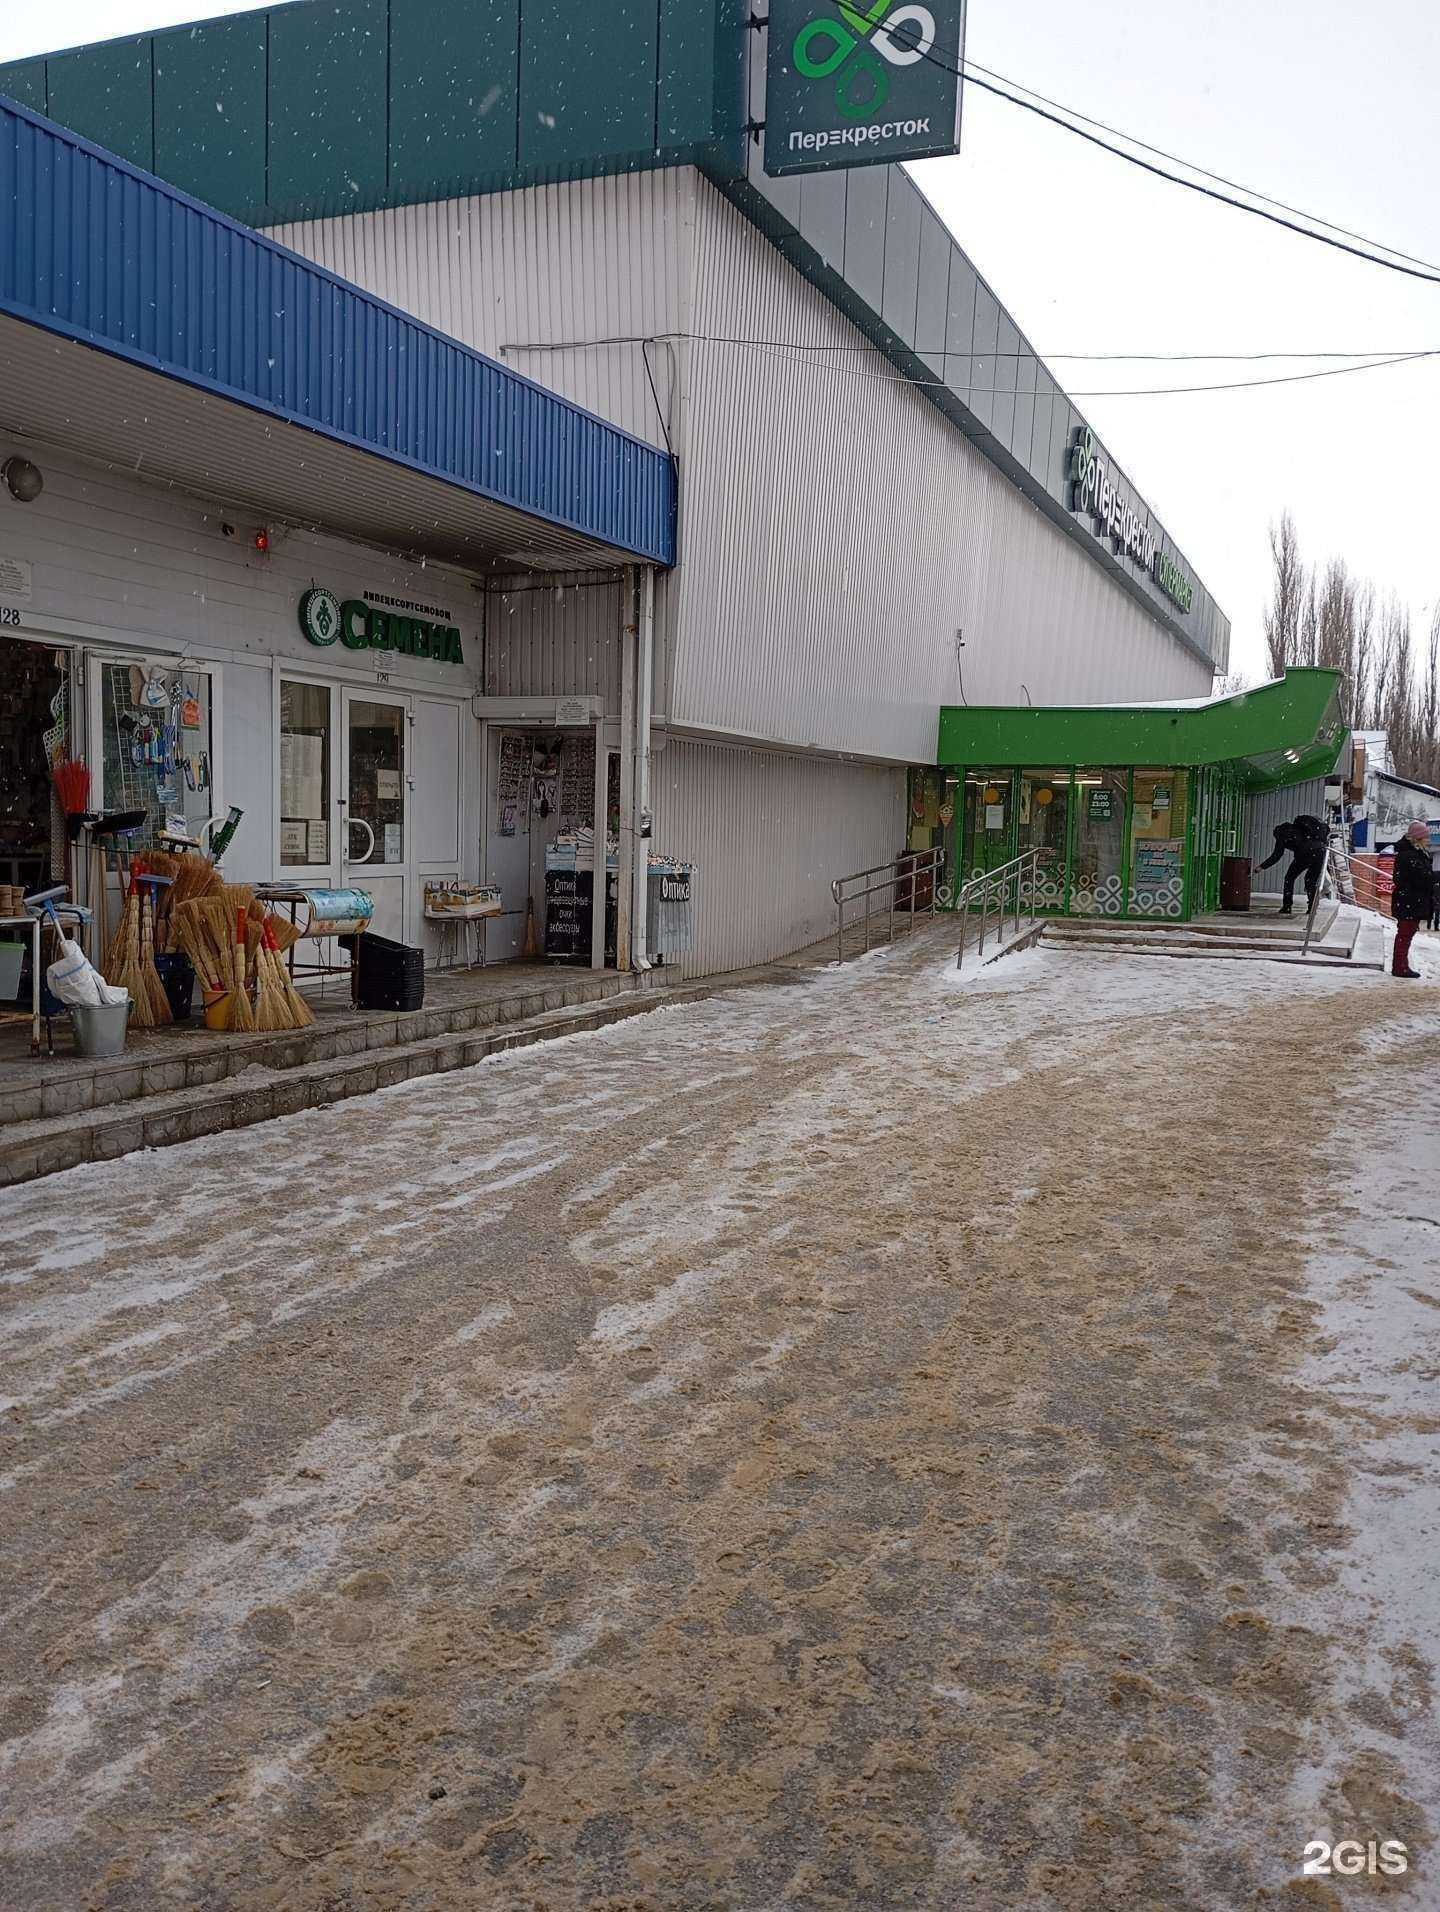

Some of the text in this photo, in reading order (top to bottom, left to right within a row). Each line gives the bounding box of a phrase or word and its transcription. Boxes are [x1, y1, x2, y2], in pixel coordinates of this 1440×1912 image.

[789, 118, 930, 152] Перекресток
[341, 600, 464, 664] СЕМЕНА
[662, 877, 690, 899] Оптика
